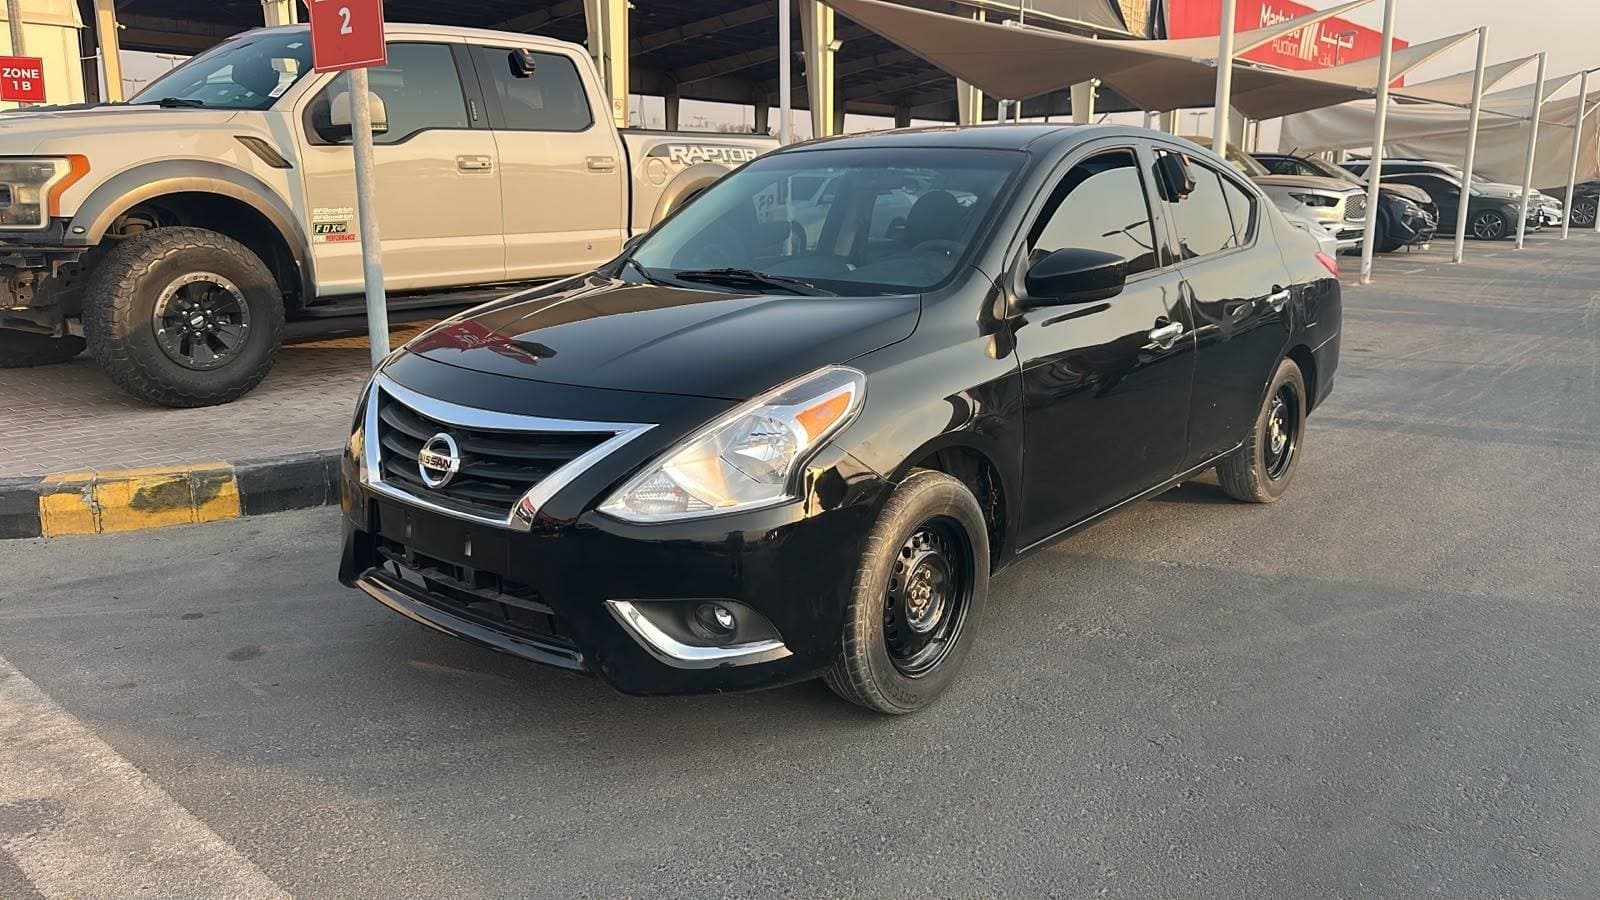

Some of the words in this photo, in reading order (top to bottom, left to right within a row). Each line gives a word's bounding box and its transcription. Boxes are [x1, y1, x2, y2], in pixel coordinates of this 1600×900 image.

[338, 7, 353, 35] 2
[2, 67, 40, 79] ZONE
[12, 80, 19, 91] 1
[22, 81, 32, 91] B
[668, 145, 758, 165] RAPTOR
[316, 224, 338, 233] FOX
[420, 452, 452, 469] NISSAN
